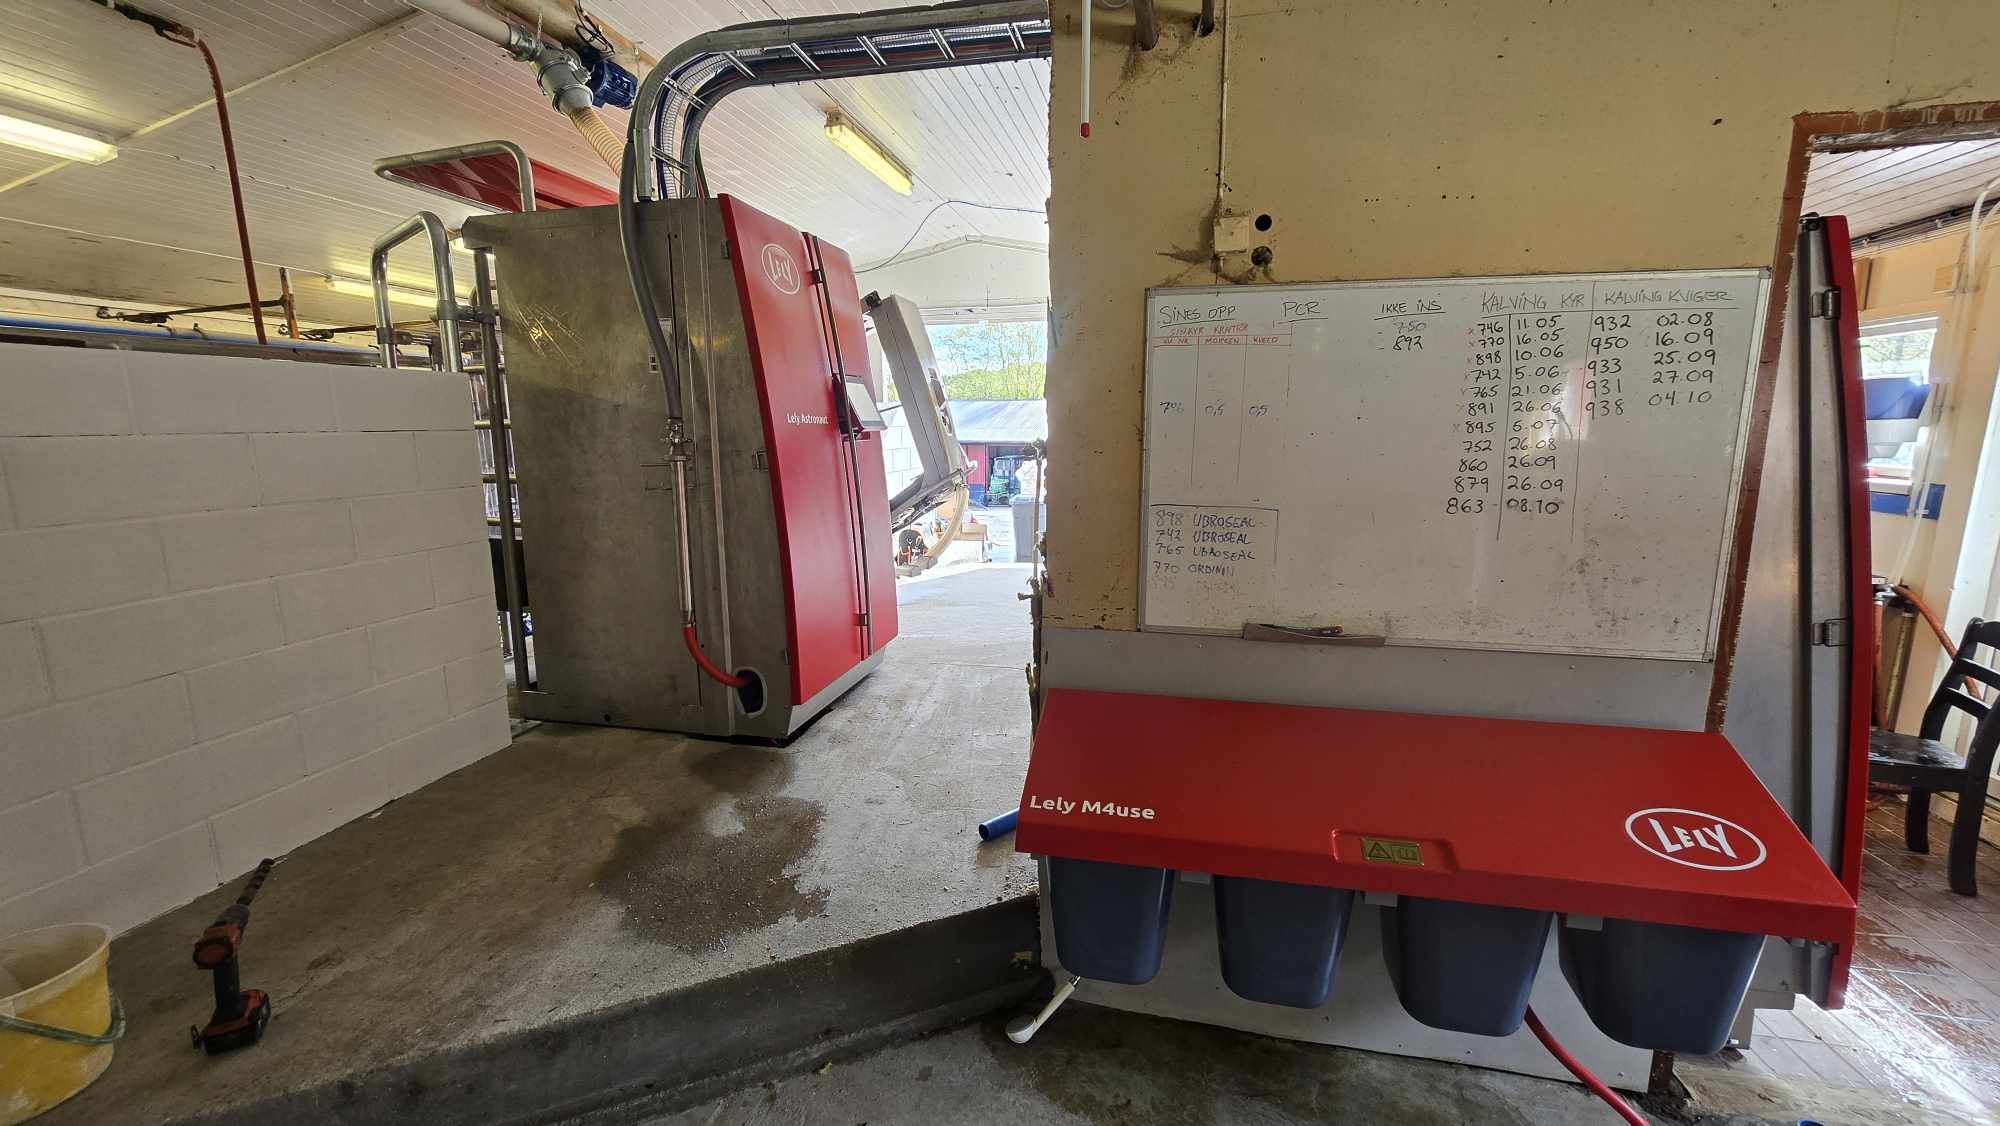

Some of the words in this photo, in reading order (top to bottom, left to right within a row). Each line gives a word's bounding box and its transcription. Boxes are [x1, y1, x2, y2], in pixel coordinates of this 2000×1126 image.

[1481, 291, 1547, 312] KALVING
[1668, 288, 1731, 302] KVIGER
[1208, 305, 1236, 319] OPP
[1283, 301, 1321, 317] PCR
[1381, 302, 1407, 314] IKKE
[1477, 321, 1504, 335] 746
[1517, 315, 1562, 330] 11.05
[1594, 314, 1632, 331] 932
[1656, 311, 1714, 327] 02.08
[1478, 337, 1505, 348] 770
[1517, 328, 1565, 345] 16.05
[1591, 336, 1629, 354] 950
[1655, 331, 1714, 347] 16.09
[1475, 350, 1502, 366] 898
[1515, 345, 1565, 361] 10.06
[1587, 358, 1622, 379] 933
[1654, 349, 1716, 366] 25.09
[1471, 369, 1502, 383] 742
[1515, 365, 1560, 380] 5.06
[1469, 385, 1499, 398] 765
[1511, 383, 1562, 397] 21.06
[1586, 379, 1622, 397] 931
[1653, 369, 1714, 384] 27.09
[1468, 402, 1494, 416] 891
[1512, 401, 1562, 415] 26.06
[1585, 399, 1624, 420] 938
[1648, 391, 1712, 406] 04.10
[787, 412, 800, 426] Lely
[1465, 420, 1497, 434] 895
[1462, 440, 1493, 453] 752
[1508, 437, 1558, 451] 26.08
[1458, 460, 1488, 473] 860
[1507, 456, 1556, 470] 26.09
[1454, 476, 1490, 493] 879
[1507, 475, 1564, 492] 26.09
[1446, 498, 1484, 514] 863
[1506, 498, 1560, 515] 08.10
[1155, 528, 1184, 542] 742
[1155, 542, 1185, 555] 765
[1153, 560, 1180, 575] 770
[1029, 795, 1076, 815] Lely
[1081, 800, 1156, 820] M4use
[1647, 817, 1739, 860] LELY
